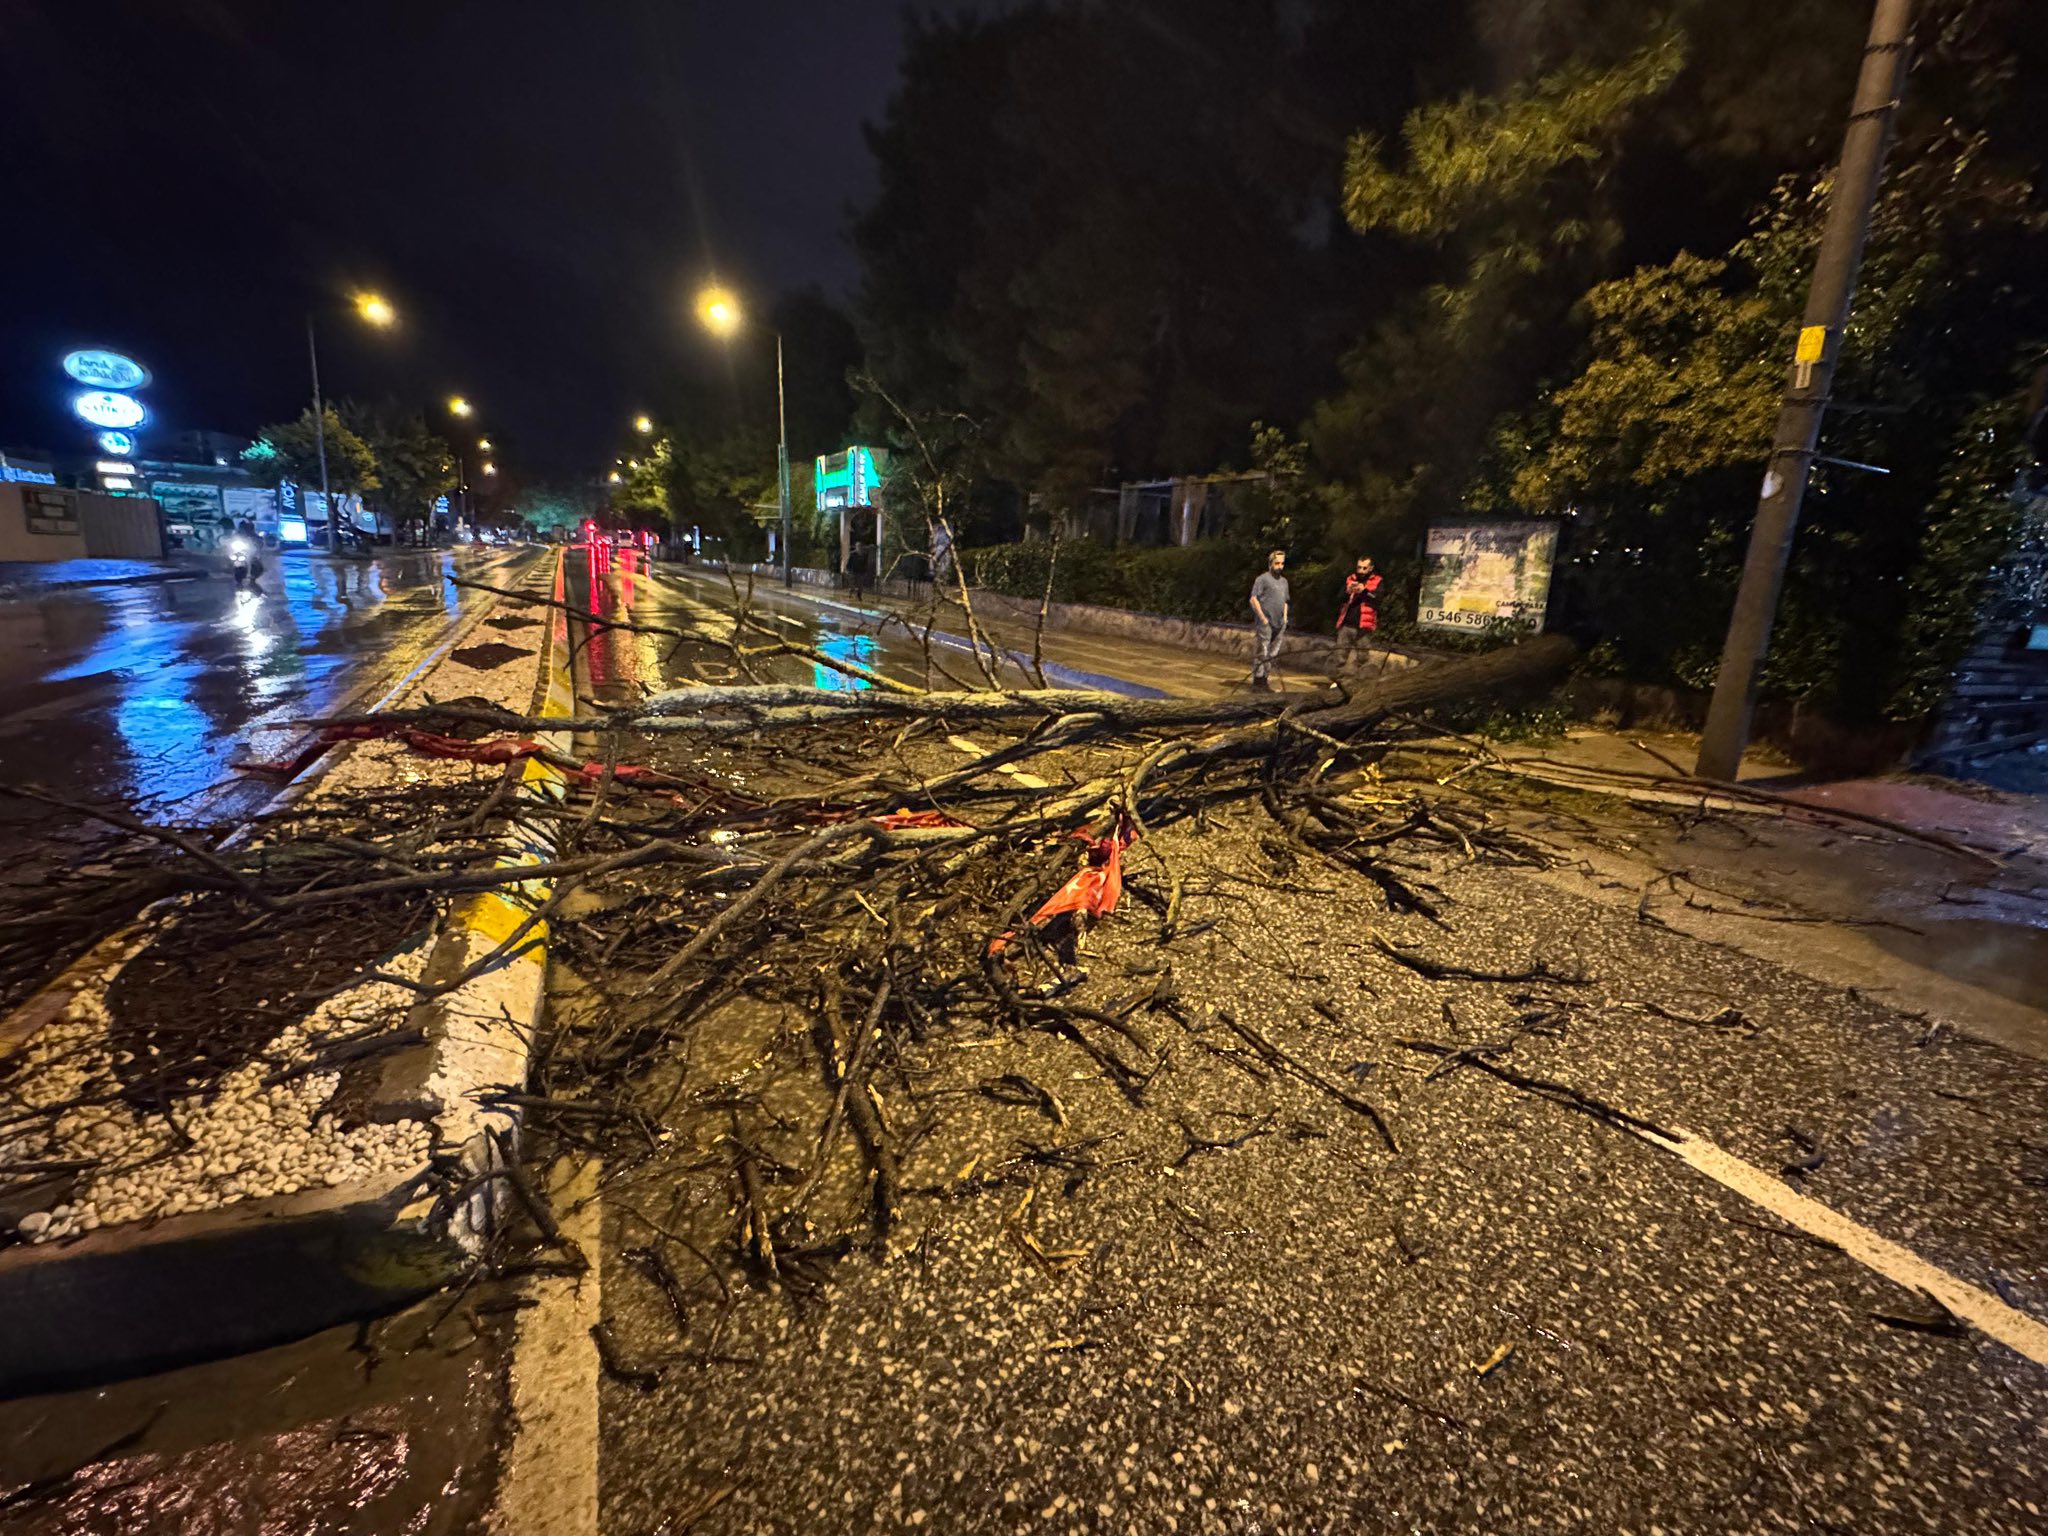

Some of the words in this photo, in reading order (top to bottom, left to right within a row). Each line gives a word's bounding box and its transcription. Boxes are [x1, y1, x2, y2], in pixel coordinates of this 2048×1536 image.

[1426, 609, 1434, 620] 0
[1438, 610, 1462, 623] 546
[1466, 613, 1491, 626] 586
